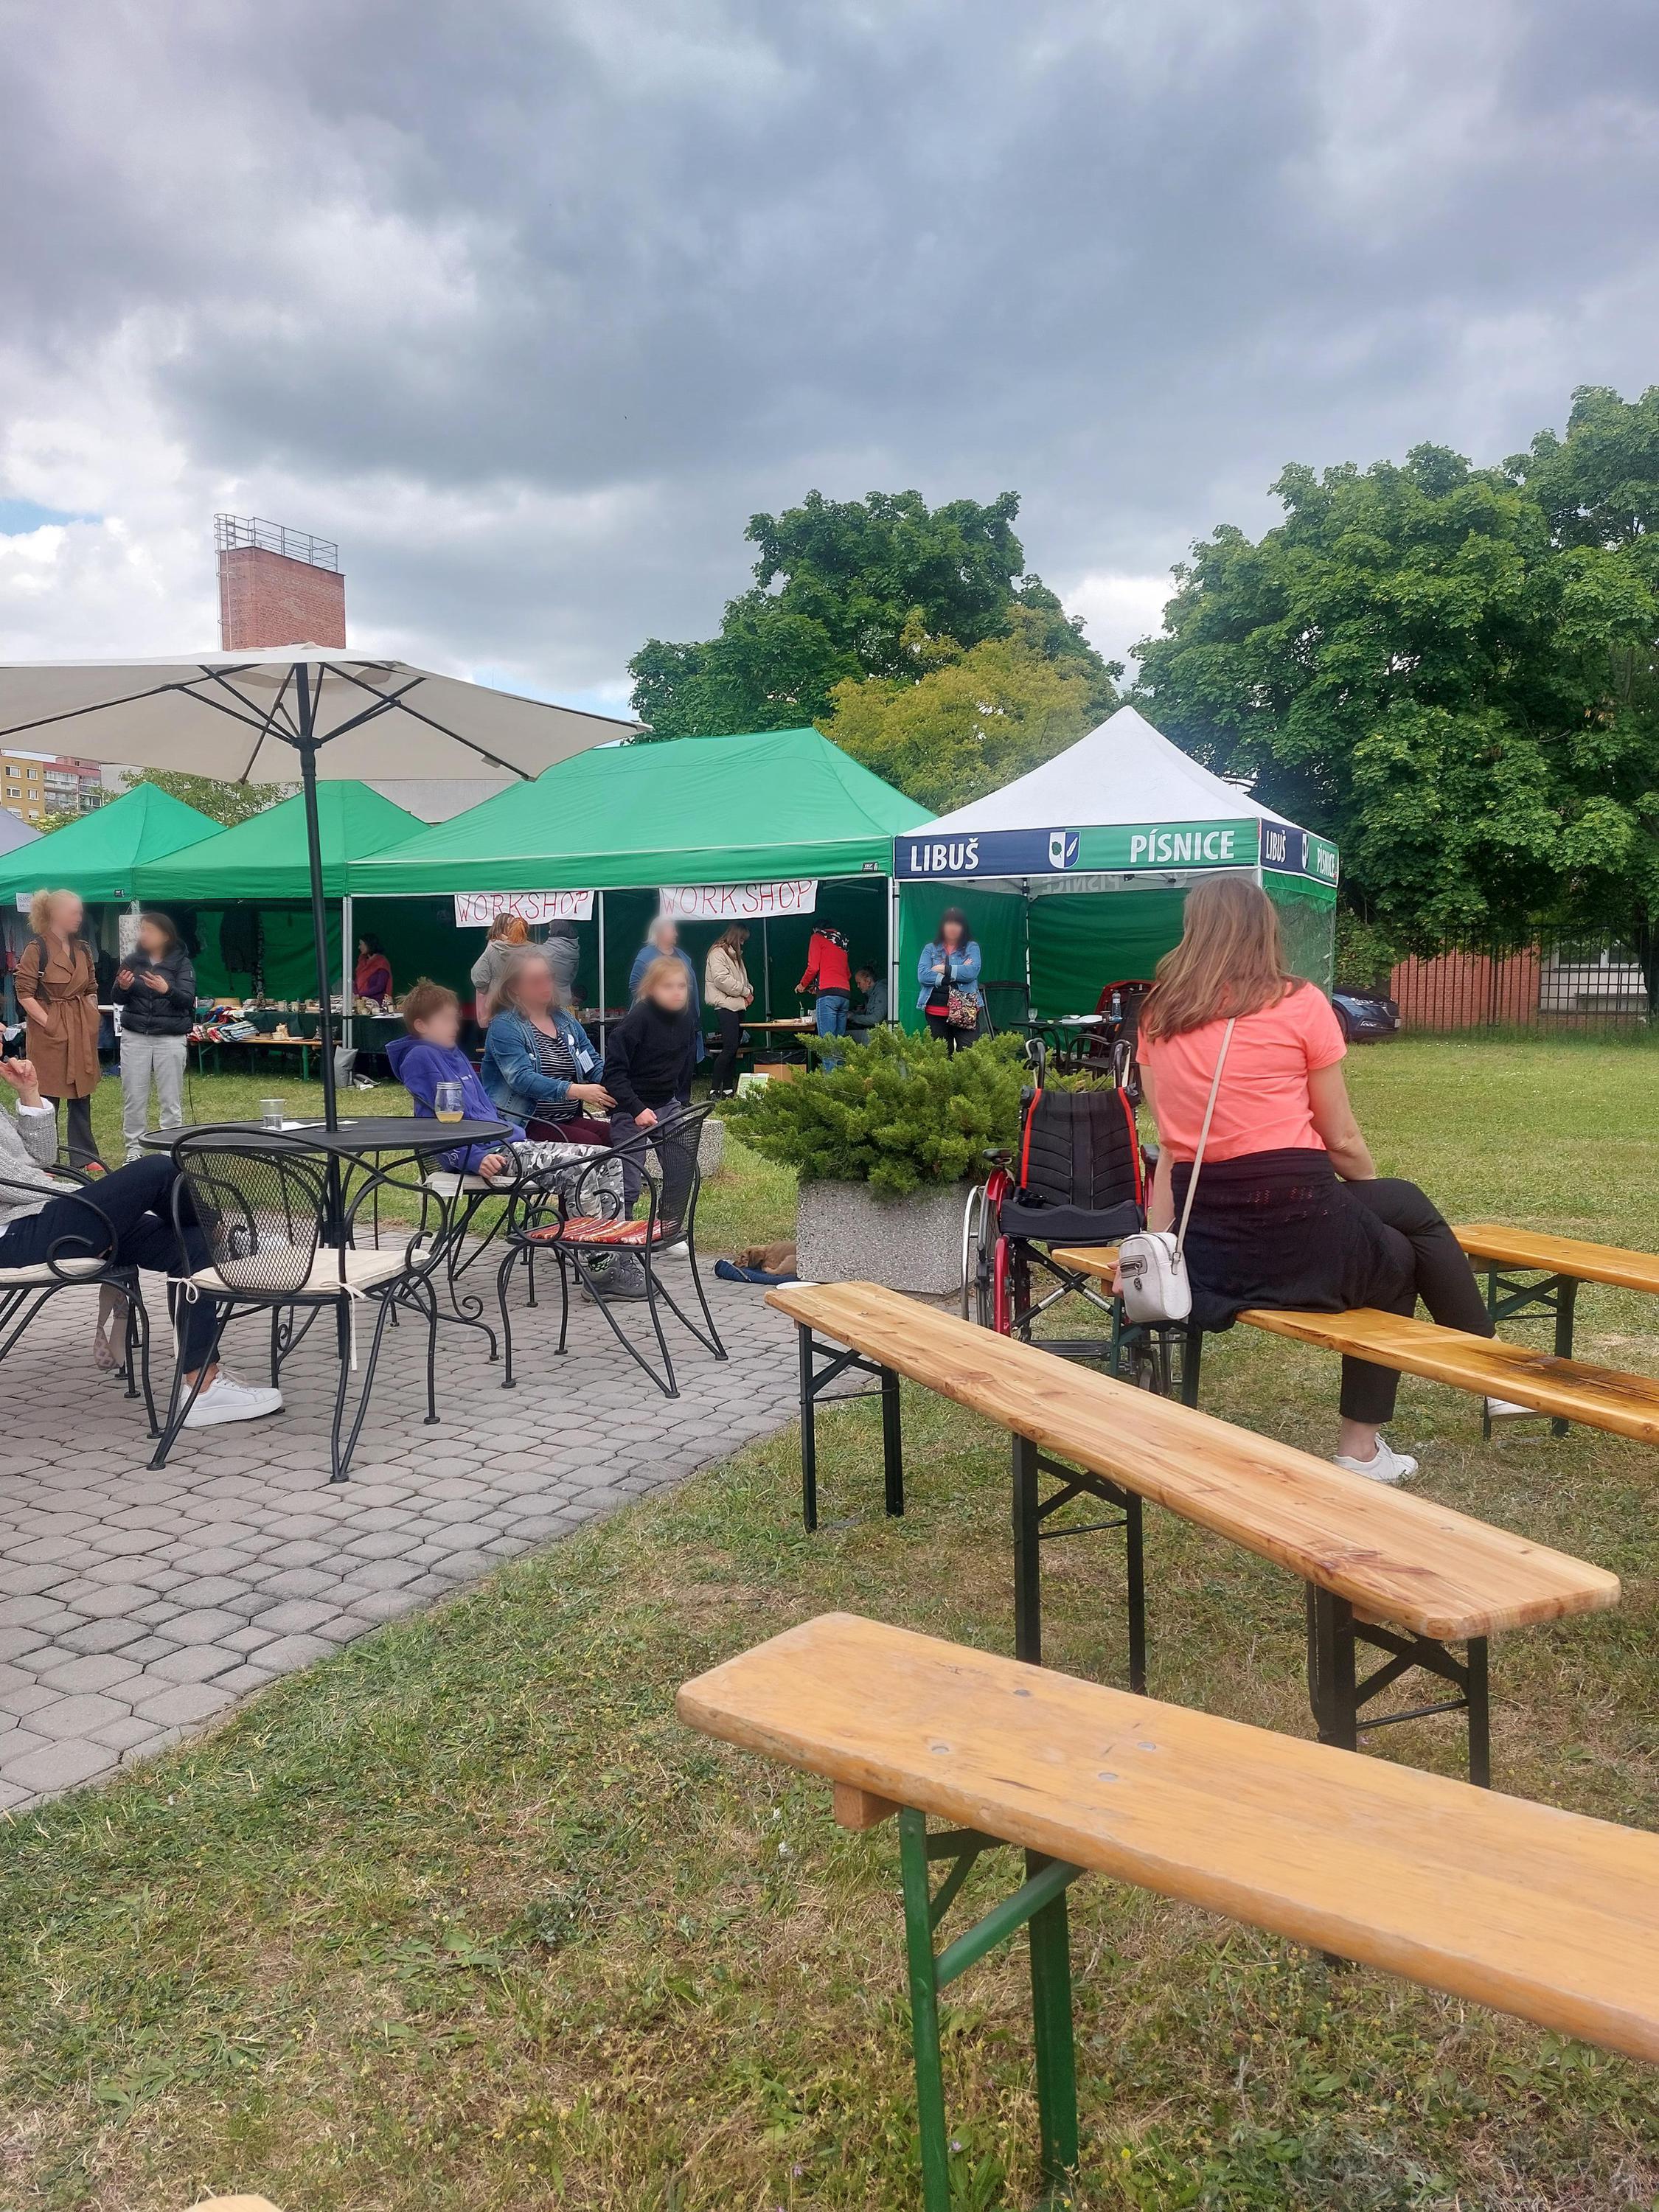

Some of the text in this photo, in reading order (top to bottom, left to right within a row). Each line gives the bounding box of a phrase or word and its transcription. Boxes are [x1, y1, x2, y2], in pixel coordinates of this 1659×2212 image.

[911, 828, 1235, 872] LIBUŠ PÍSNICE
[1266, 830, 1286, 863] LIBUŠ
[456, 891, 588, 922] WORKSHOP
